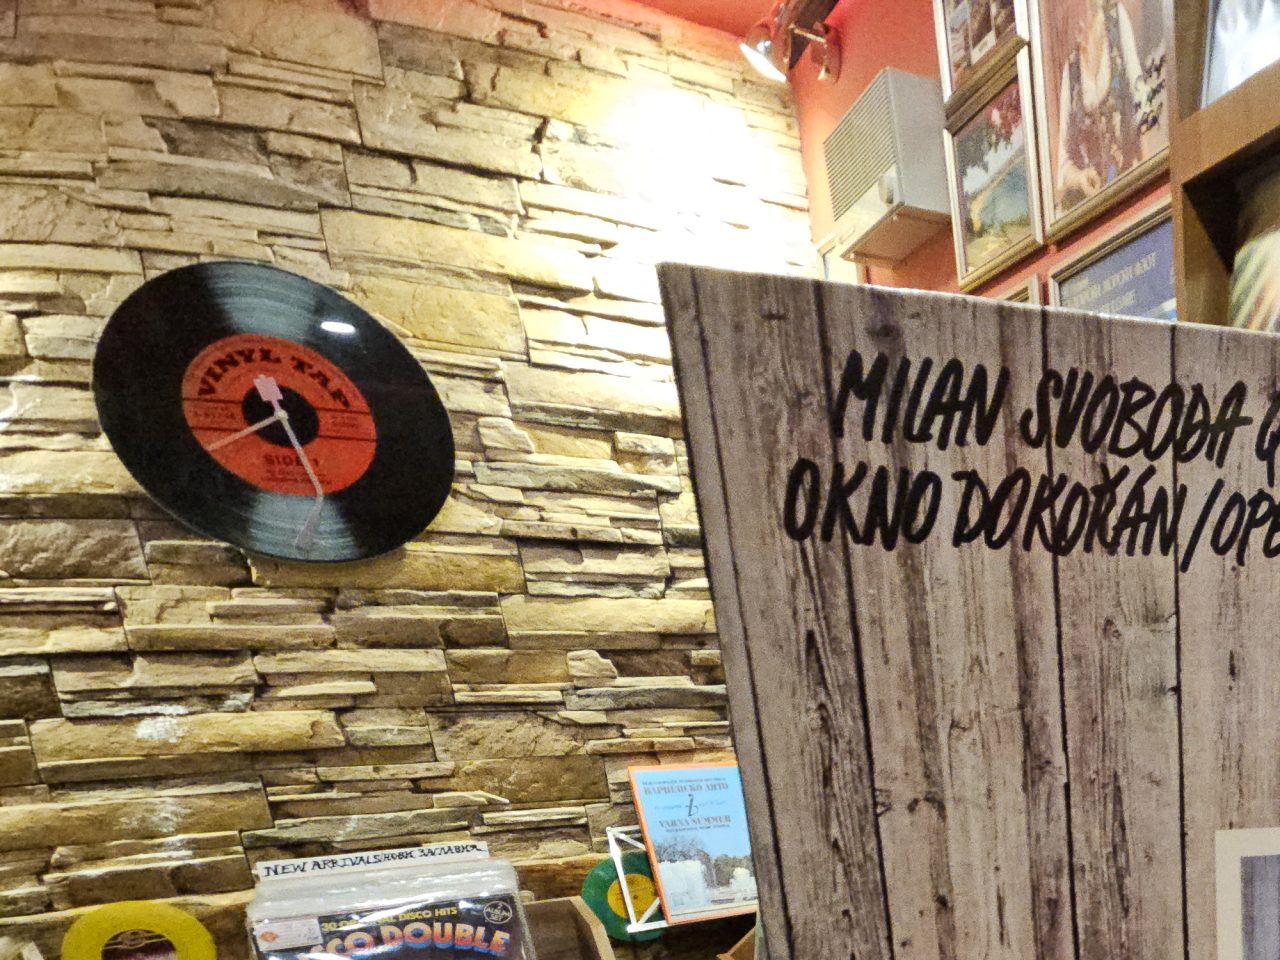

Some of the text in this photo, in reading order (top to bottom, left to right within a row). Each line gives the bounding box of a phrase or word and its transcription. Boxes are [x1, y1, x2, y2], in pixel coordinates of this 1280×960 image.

[198, 348, 350, 408] VINYL TAP
[834, 349, 1010, 450] MILAN
[1019, 368, 1253, 467] SVOBODA
[784, 458, 943, 552] OKNO
[264, 862, 308, 878] NEW
[434, 906, 458, 917] HITS
[380, 921, 511, 957] DOUBLE
